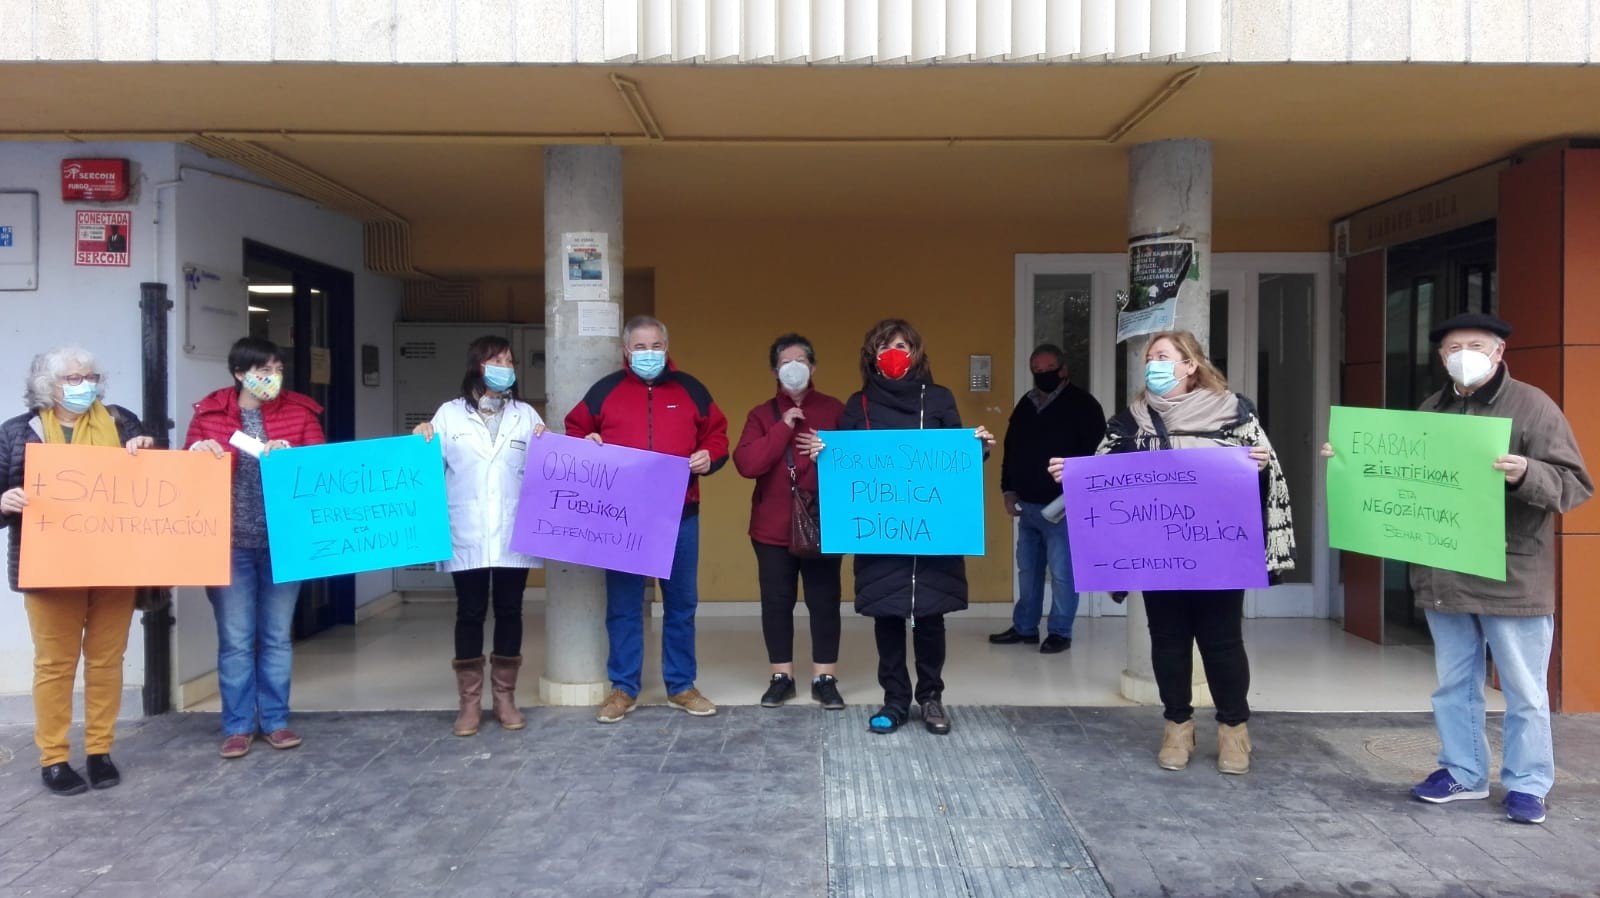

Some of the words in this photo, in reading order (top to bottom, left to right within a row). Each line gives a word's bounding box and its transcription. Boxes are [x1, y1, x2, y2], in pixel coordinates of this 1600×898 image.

[79, 172, 116, 180] SERCOIN
[78, 212, 128, 225] CONECTADA
[78, 252, 127, 264] SERCOIN
[832, 447, 863, 472] POR
[868, 453, 895, 471] UNA
[898, 444, 972, 473] SANIDAD
[1352, 431, 1428, 460] ERABAKI
[292, 463, 424, 500] LANGILEAK
[542, 451, 619, 491] OSASUN
[1085, 470, 1198, 491] INVERSIONES
[1362, 460, 1460, 486] ZIENTIFIKOAK
[851, 477, 943, 505] PÚBLICA
[1398, 489, 1417, 500] ETA
[310, 500, 417, 525] ERRESPETATU
[549, 489, 629, 526] PUBLIKOA
[1109, 498, 1196, 525] SANIDAD
[1362, 497, 1461, 529] NEGOZIATUAK
[62, 510, 217, 537] CONTRATACIÓN
[851, 512, 932, 541] DIGNA
[1163, 519, 1249, 542] PÚBLICA
[1383, 523, 1423, 543] BEHAR
[1426, 531, 1458, 550] DUGU
[1113, 557, 1198, 571] CEMENTO
